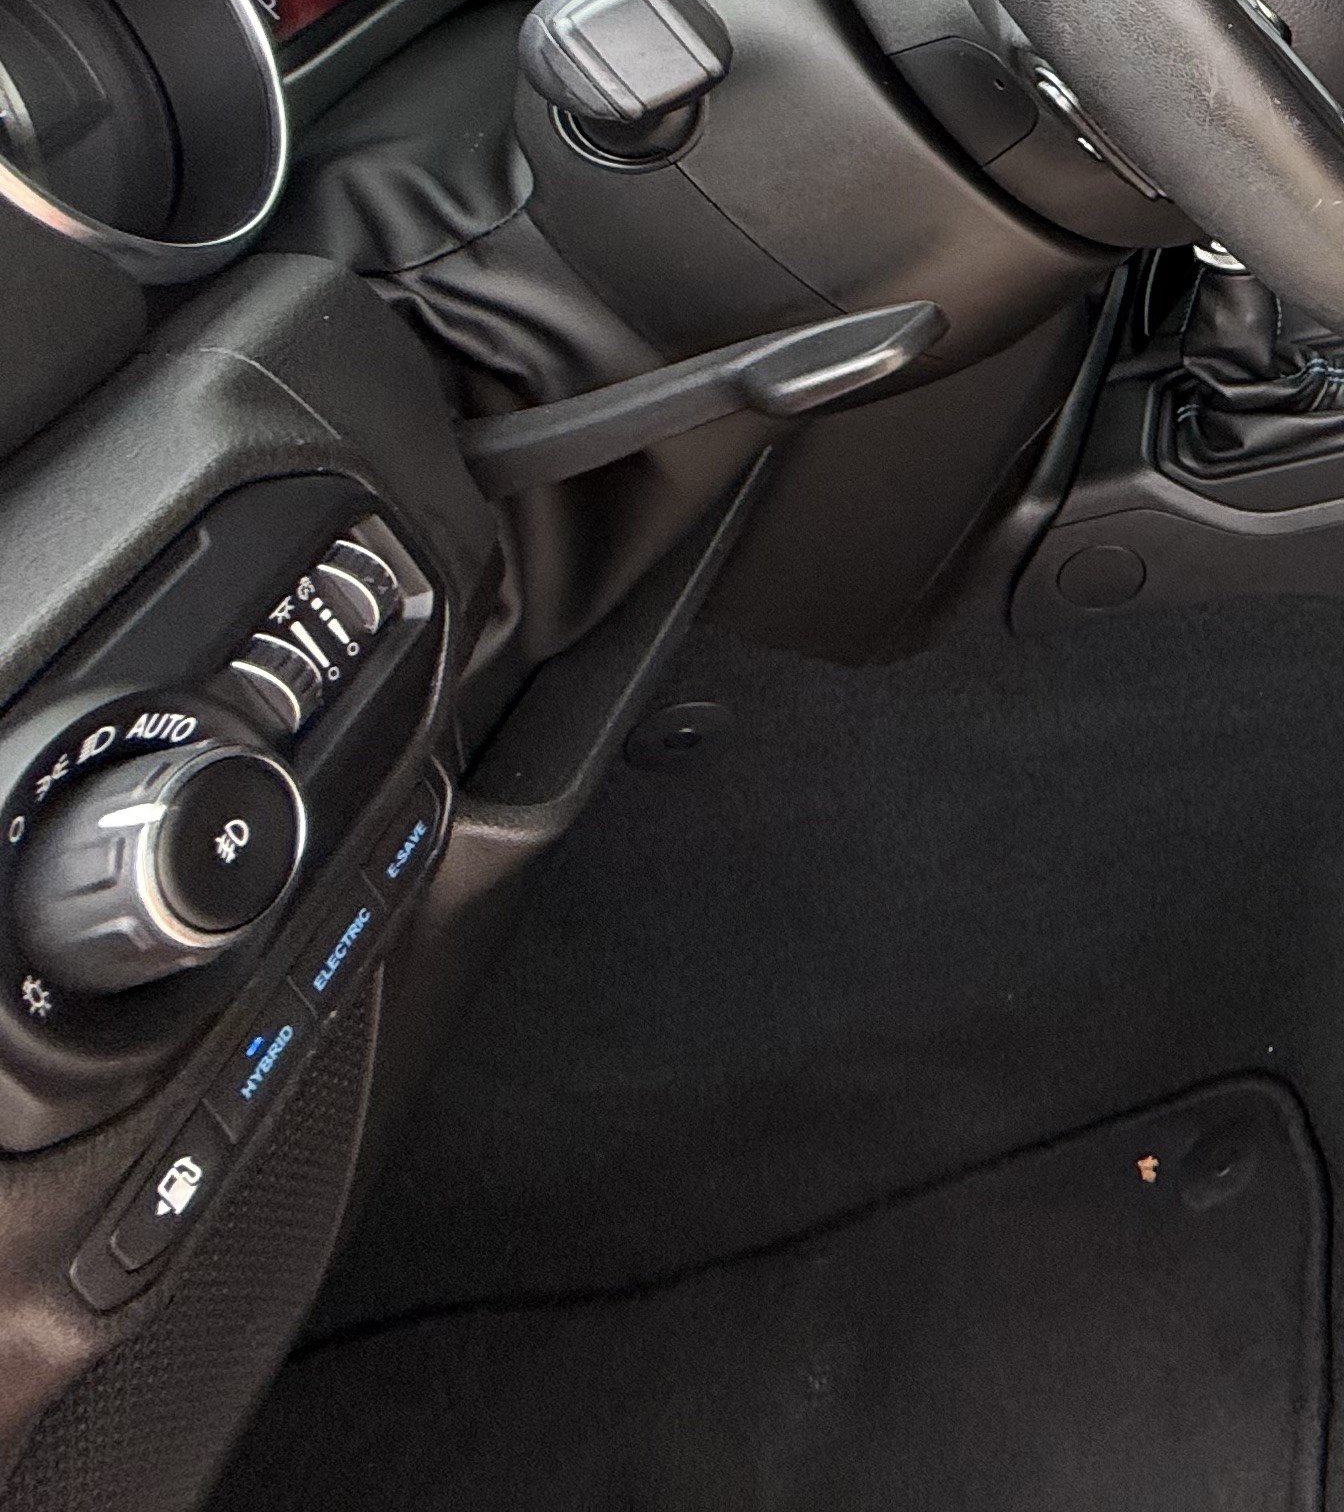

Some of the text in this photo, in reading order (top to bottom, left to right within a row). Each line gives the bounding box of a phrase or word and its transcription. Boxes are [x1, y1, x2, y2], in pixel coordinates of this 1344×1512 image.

[125, 713, 197, 743] AUTO
[386, 819, 428, 879] E-SAVE
[312, 907, 371, 992] ELECTRIC
[240, 1024, 294, 1100] HYBRID
